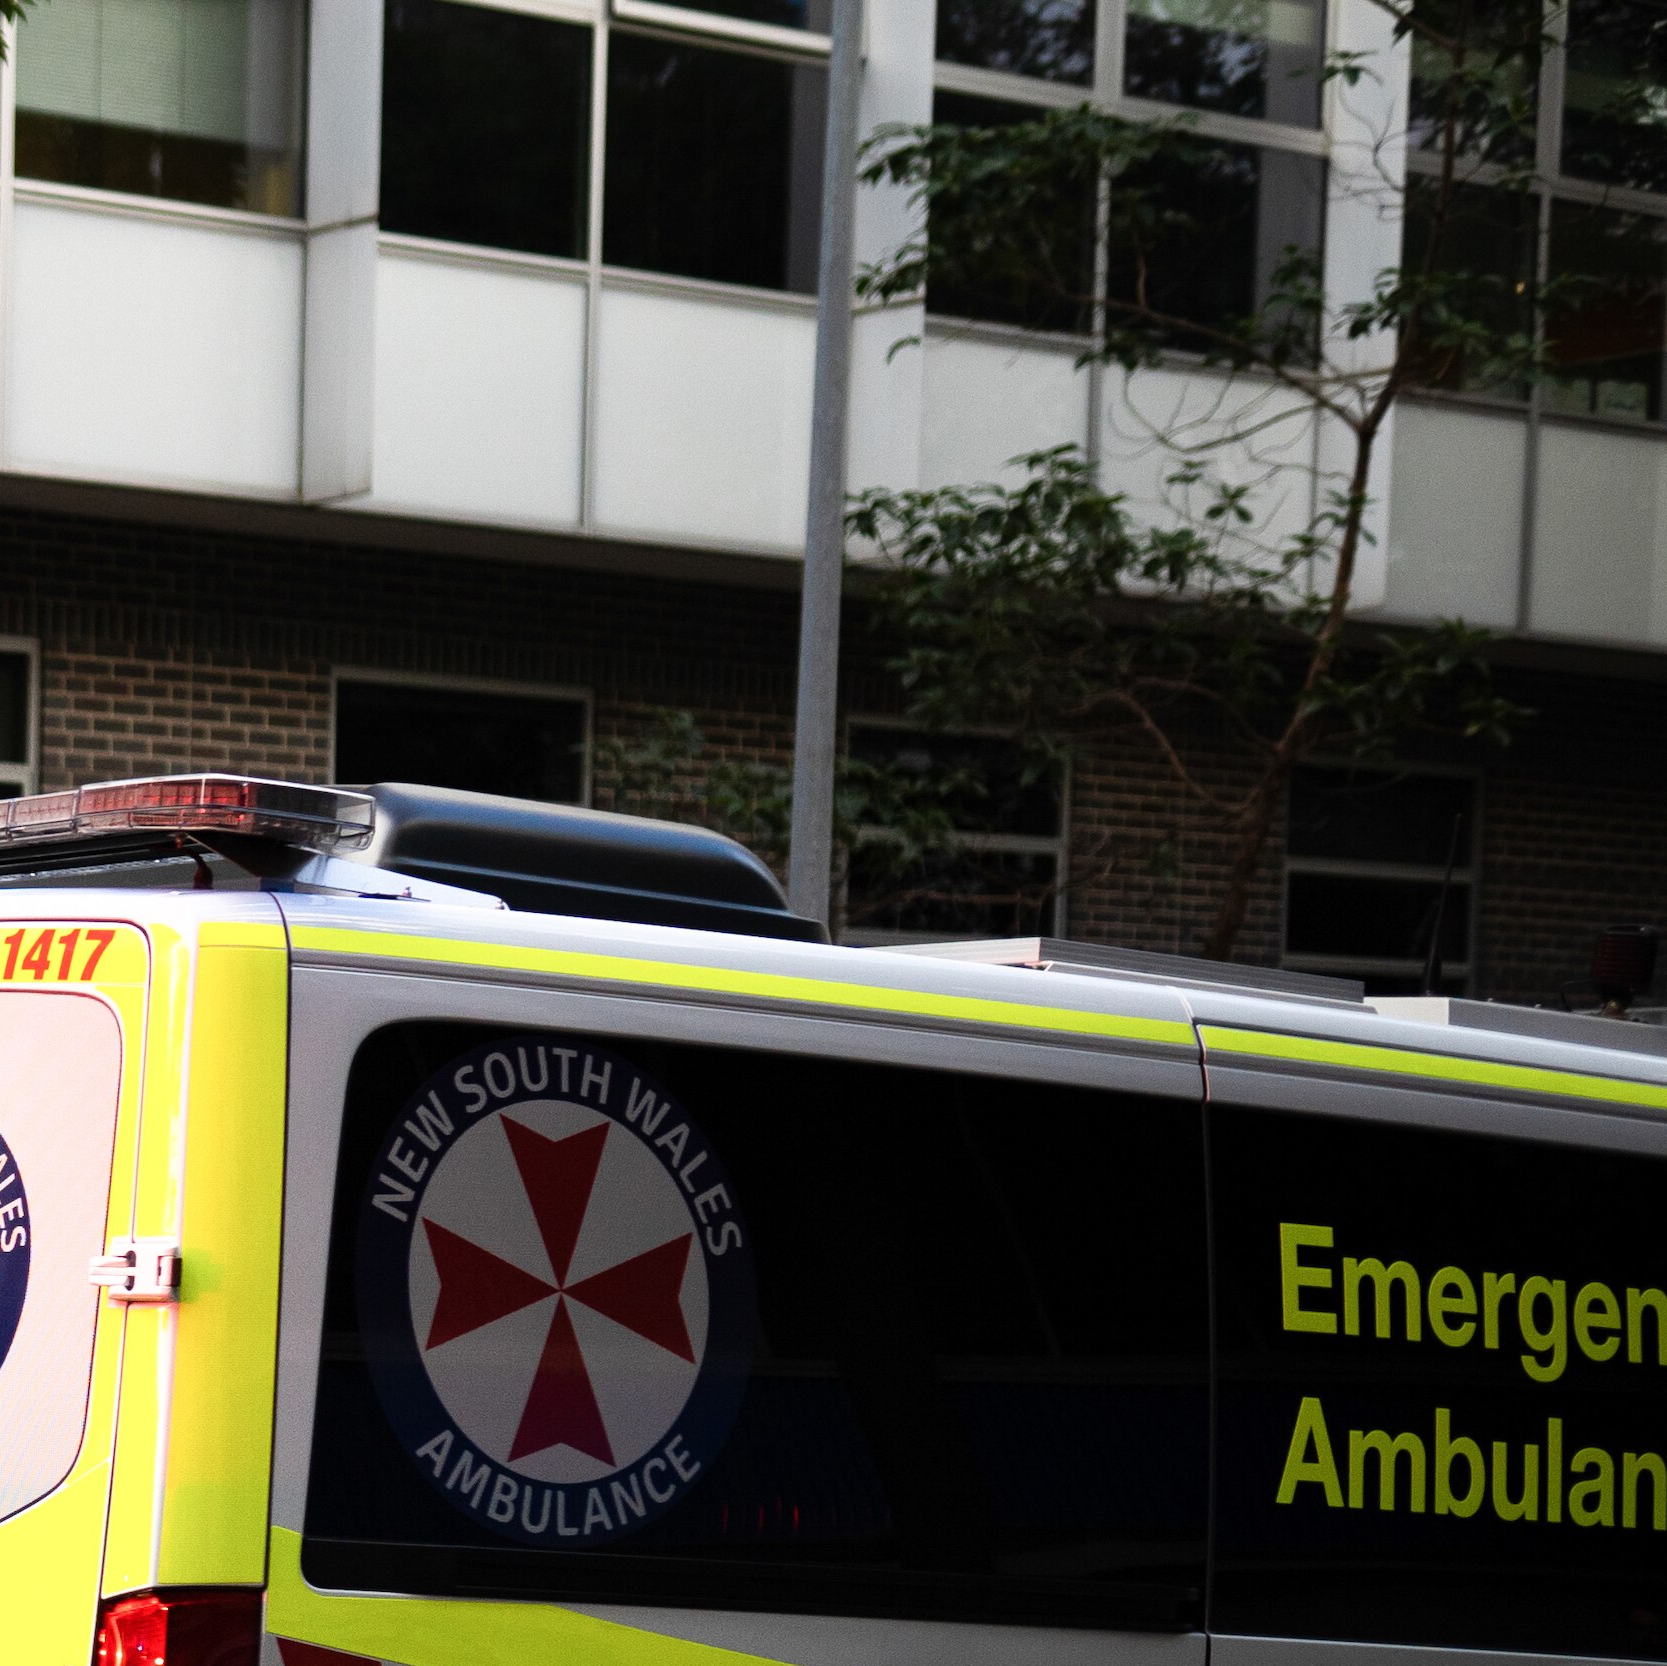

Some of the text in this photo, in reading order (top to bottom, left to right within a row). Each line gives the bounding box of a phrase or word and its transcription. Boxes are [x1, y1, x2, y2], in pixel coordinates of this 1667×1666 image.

[3, 928, 116, 981] 1417
[371, 1045, 742, 1256] NEW SOUTH WALES
[1279, 1222, 1667, 1382] Emergen
[416, 1429, 702, 1536] AMBULANCE
[1276, 1397, 1667, 1531] Ambulan
